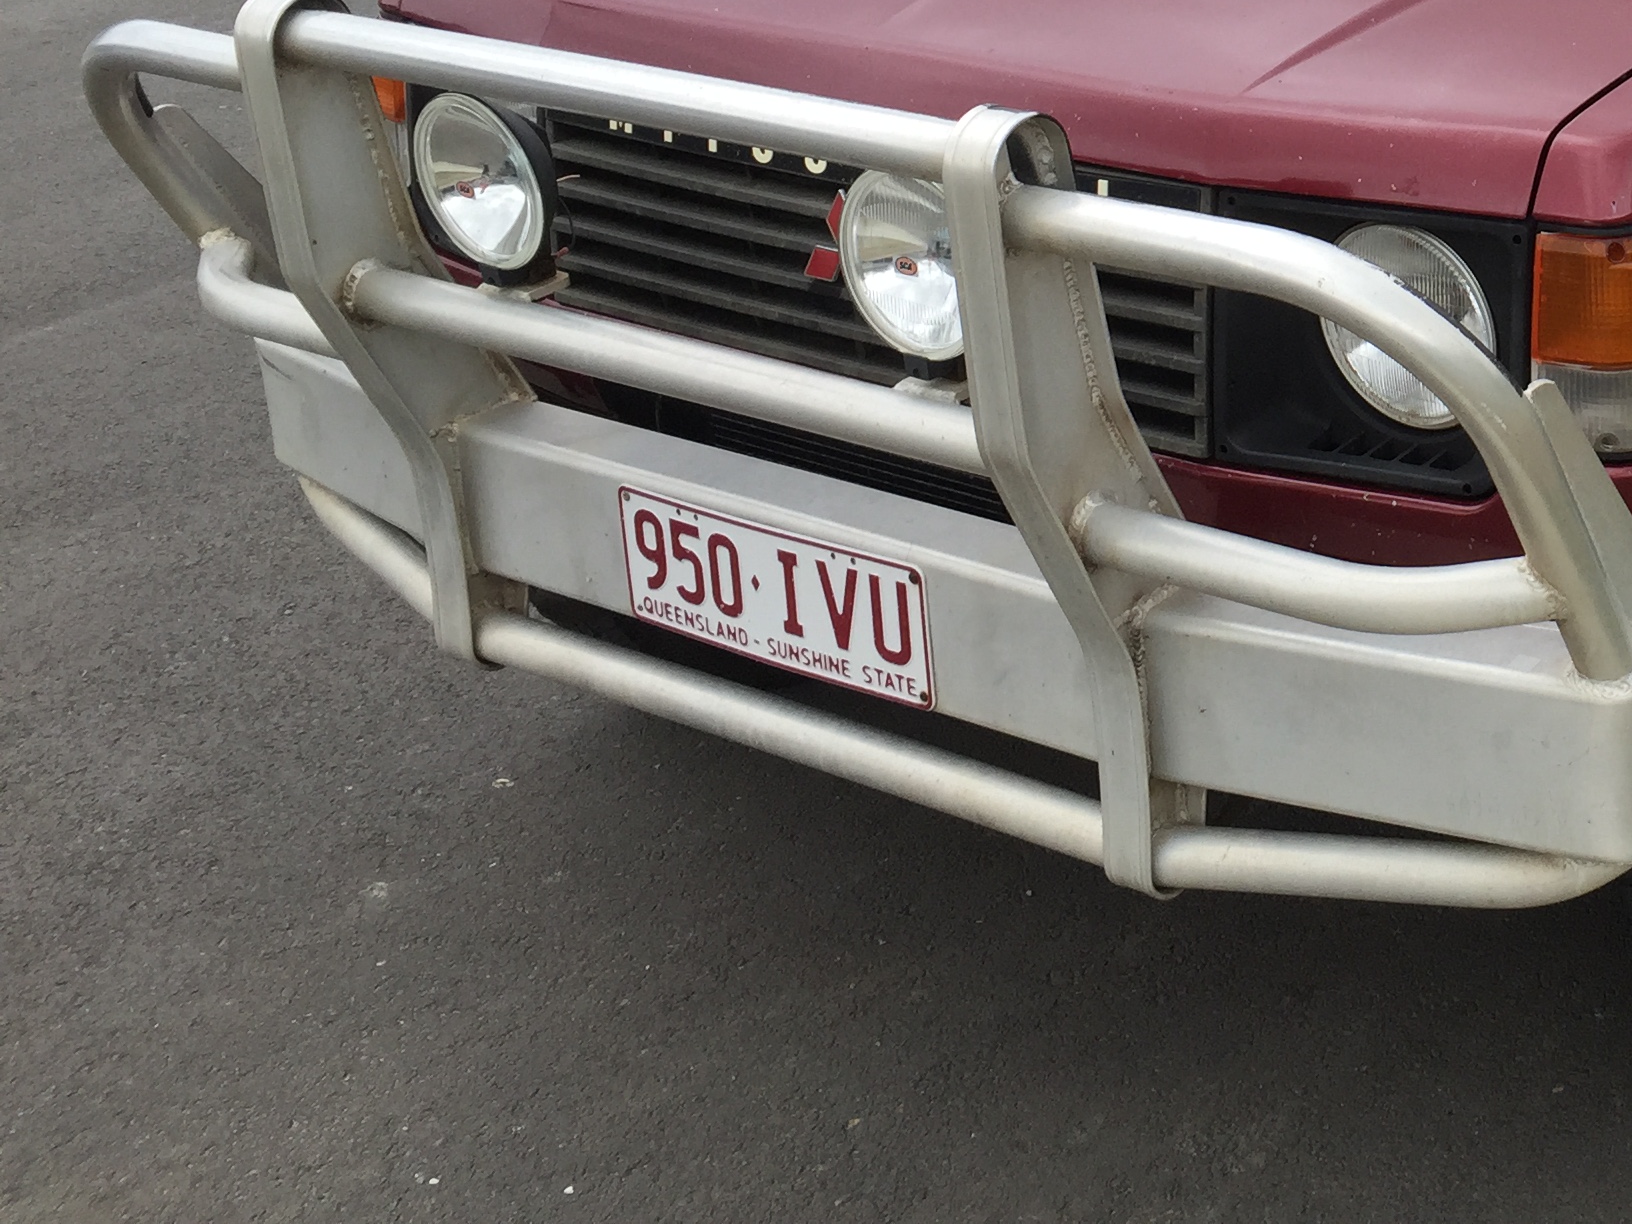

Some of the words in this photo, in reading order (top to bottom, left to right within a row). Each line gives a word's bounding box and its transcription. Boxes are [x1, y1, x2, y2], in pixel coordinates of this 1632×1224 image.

[642, 595, 749, 647] QUEENSLAND
[767, 638, 851, 677] SUNSHINE
[862, 665, 917, 697] STATE
